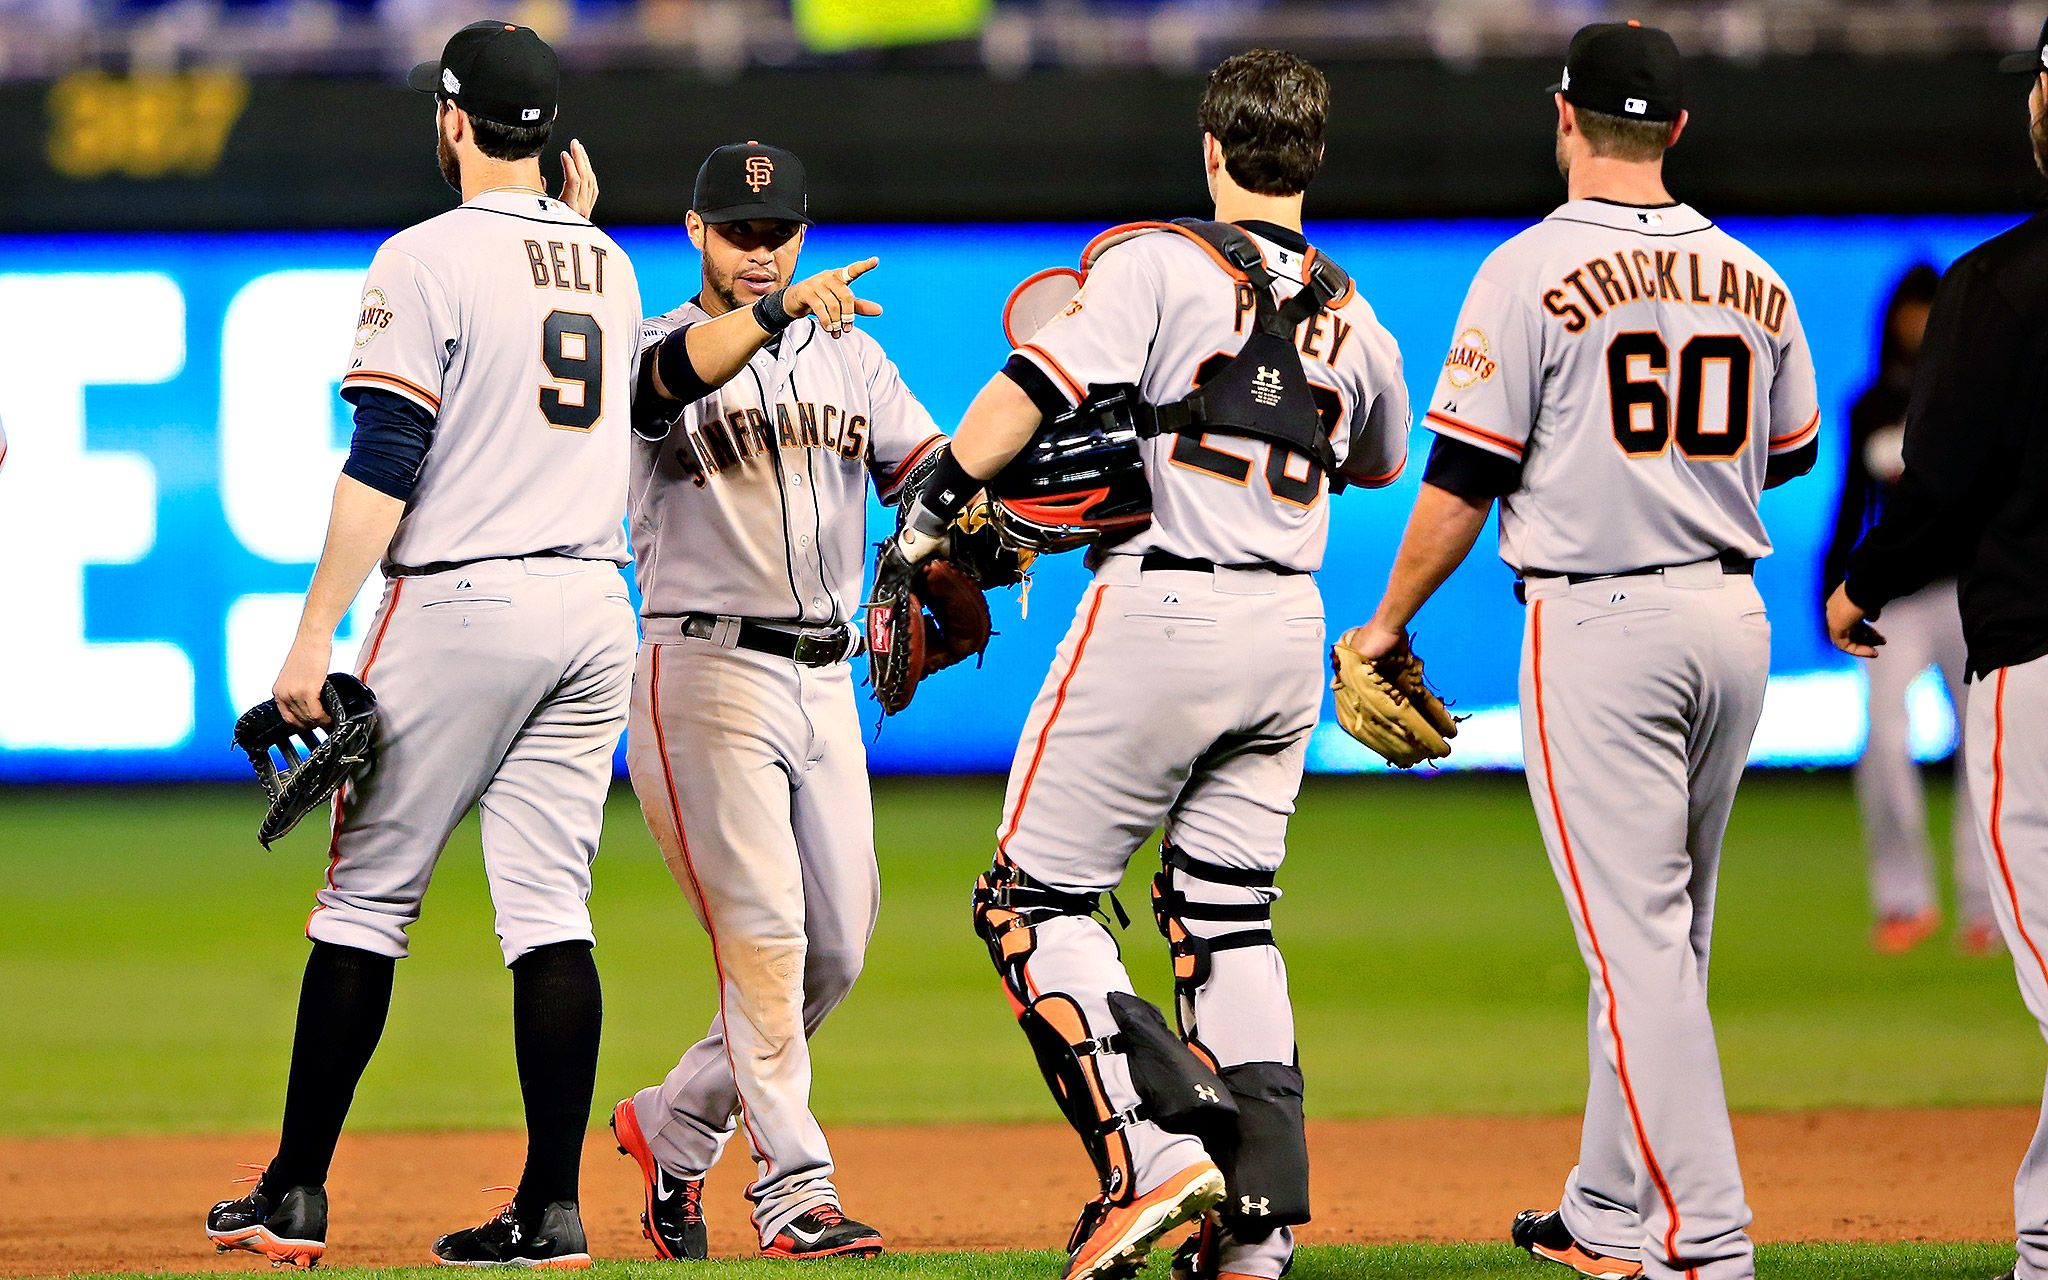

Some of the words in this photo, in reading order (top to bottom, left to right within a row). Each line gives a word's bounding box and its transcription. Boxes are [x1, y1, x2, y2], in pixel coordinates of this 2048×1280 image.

[745, 156, 774, 193] SF
[523, 239, 608, 297] BELT
[1543, 249, 1788, 336] STRICKLAND
[1234, 281, 1351, 368] PEY
[537, 307, 605, 434] 9
[1606, 330, 1754, 461] 60
